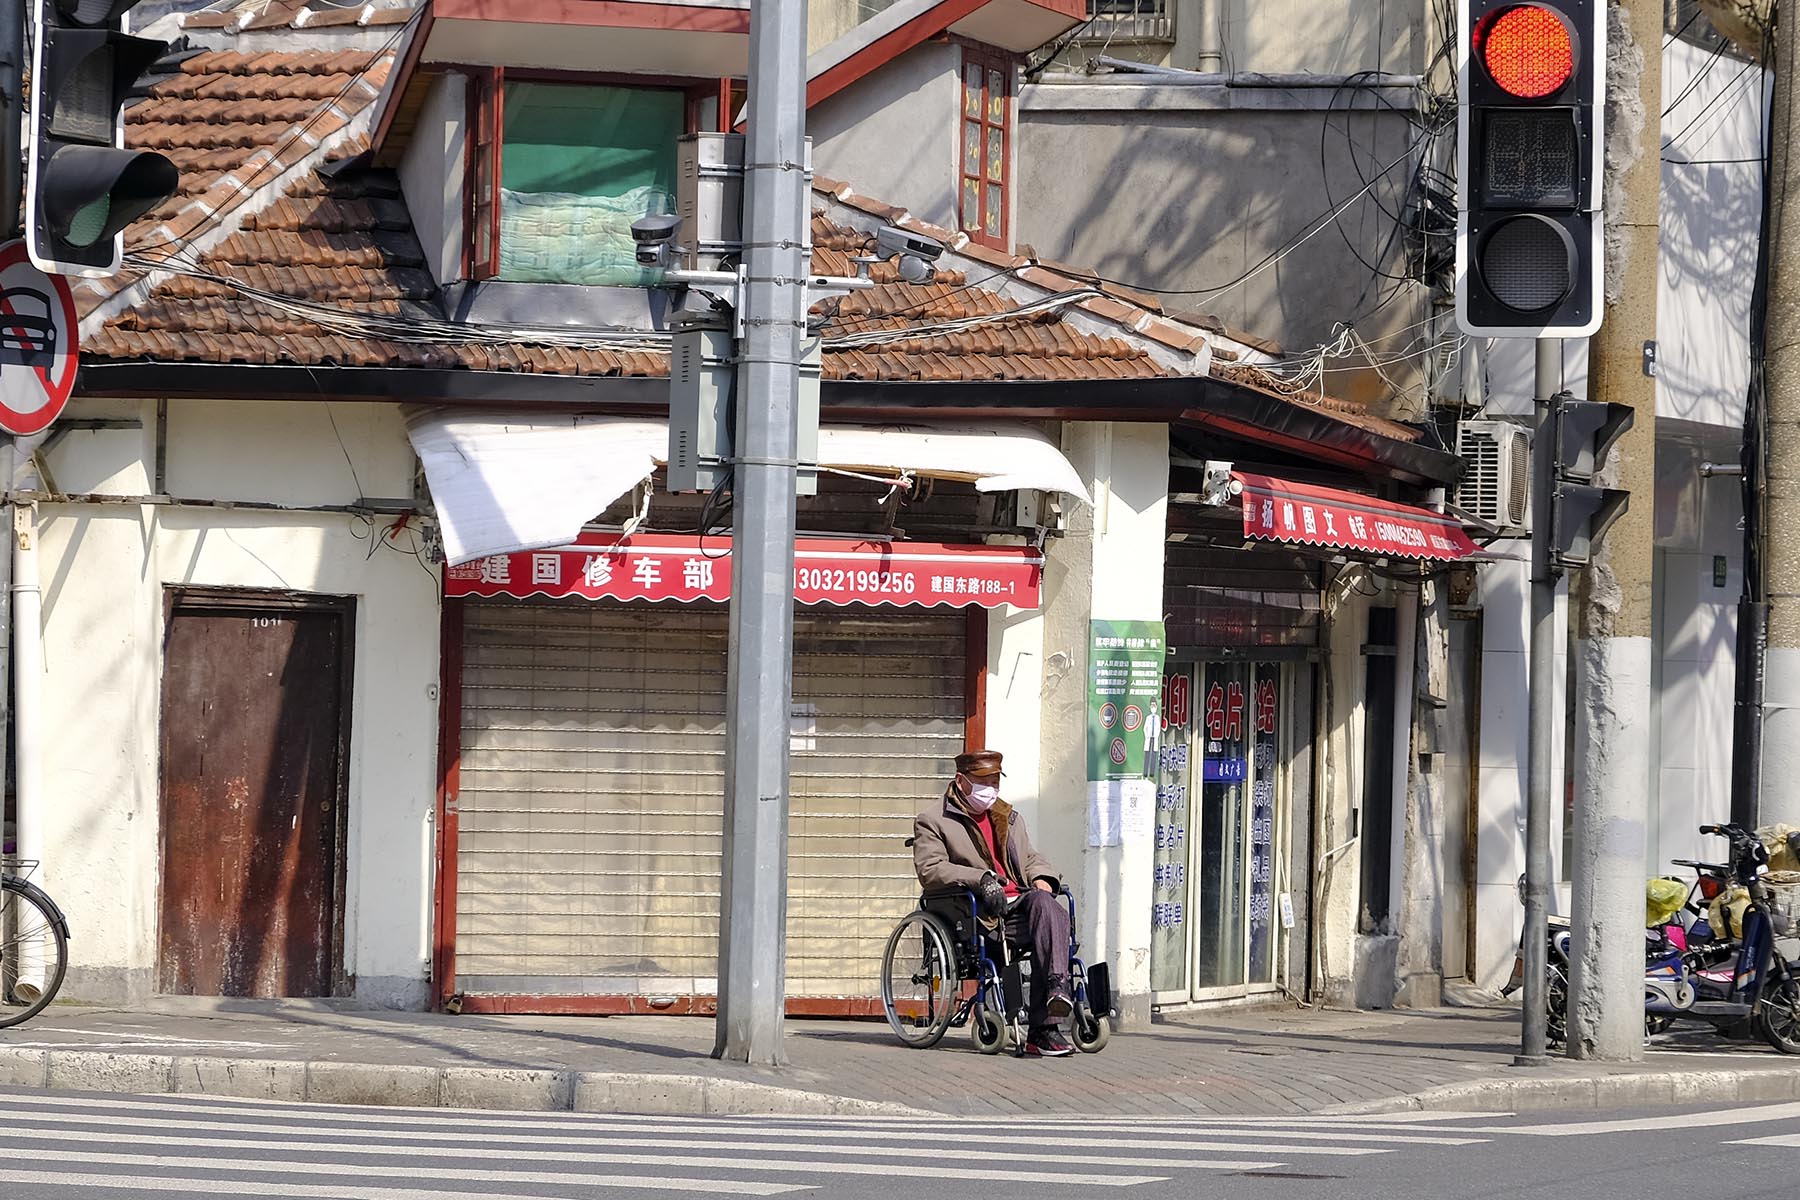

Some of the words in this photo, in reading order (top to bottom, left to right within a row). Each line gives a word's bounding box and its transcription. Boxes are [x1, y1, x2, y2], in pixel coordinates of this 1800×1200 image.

[1261, 499, 1338, 537] 扬帆图文
[480, 553, 714, 590] 建国修车部
[930, 576, 1016, 595] 建国东路188-1
[1206, 680, 1244, 741] 名片
[1254, 679, 1277, 734] 绘
